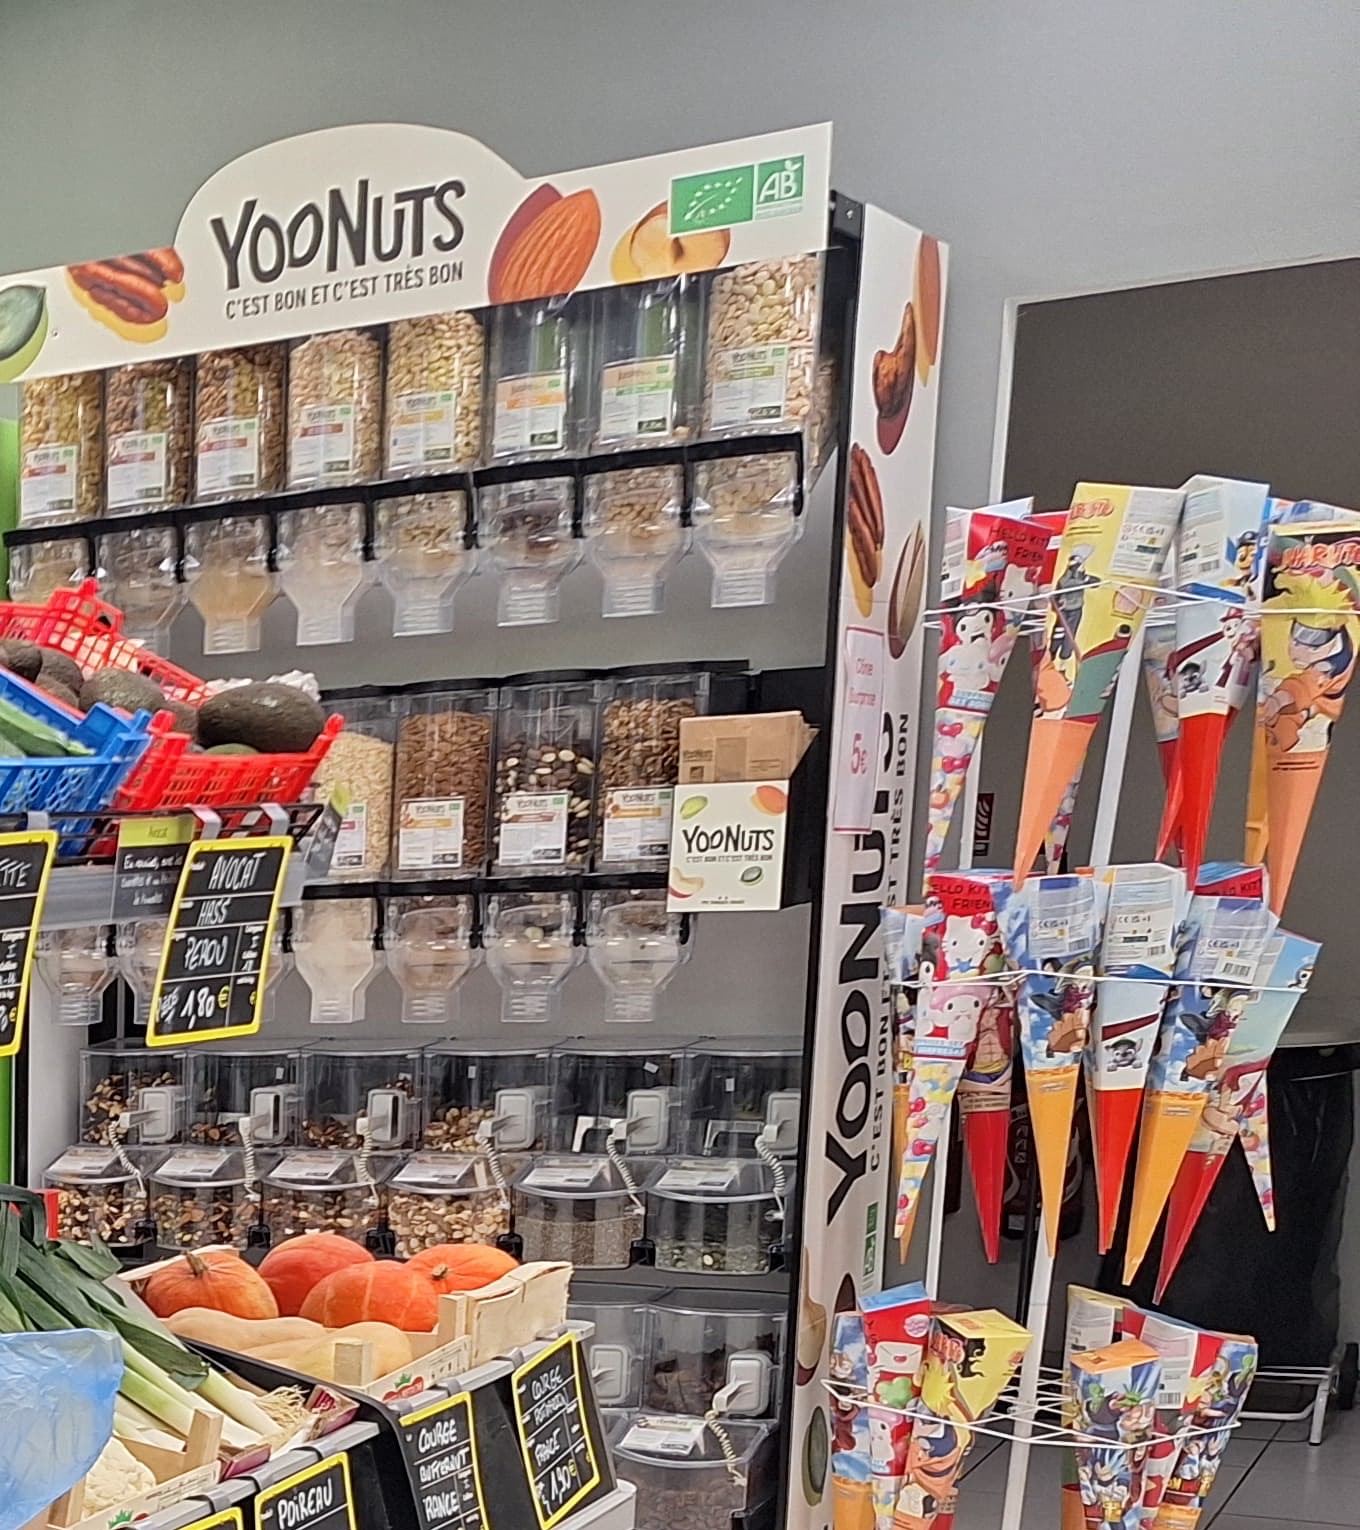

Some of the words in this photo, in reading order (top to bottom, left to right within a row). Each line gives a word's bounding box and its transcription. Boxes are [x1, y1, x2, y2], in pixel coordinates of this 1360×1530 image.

[226, 296, 269, 320] C'EST
[275, 286, 306, 312] BON
[311, 282, 331, 306] ET
[333, 273, 379, 302] C'EST
[384, 264, 424, 292] TRÈS
[429, 260, 464, 286] BON
[895, 713, 909, 777] BON
[888, 789, 905, 866] TRÈS
[207, 852, 267, 891] AVOCAT
[180, 986, 216, 1030] 1,80
[418, 1418, 458, 1454] COURGE
